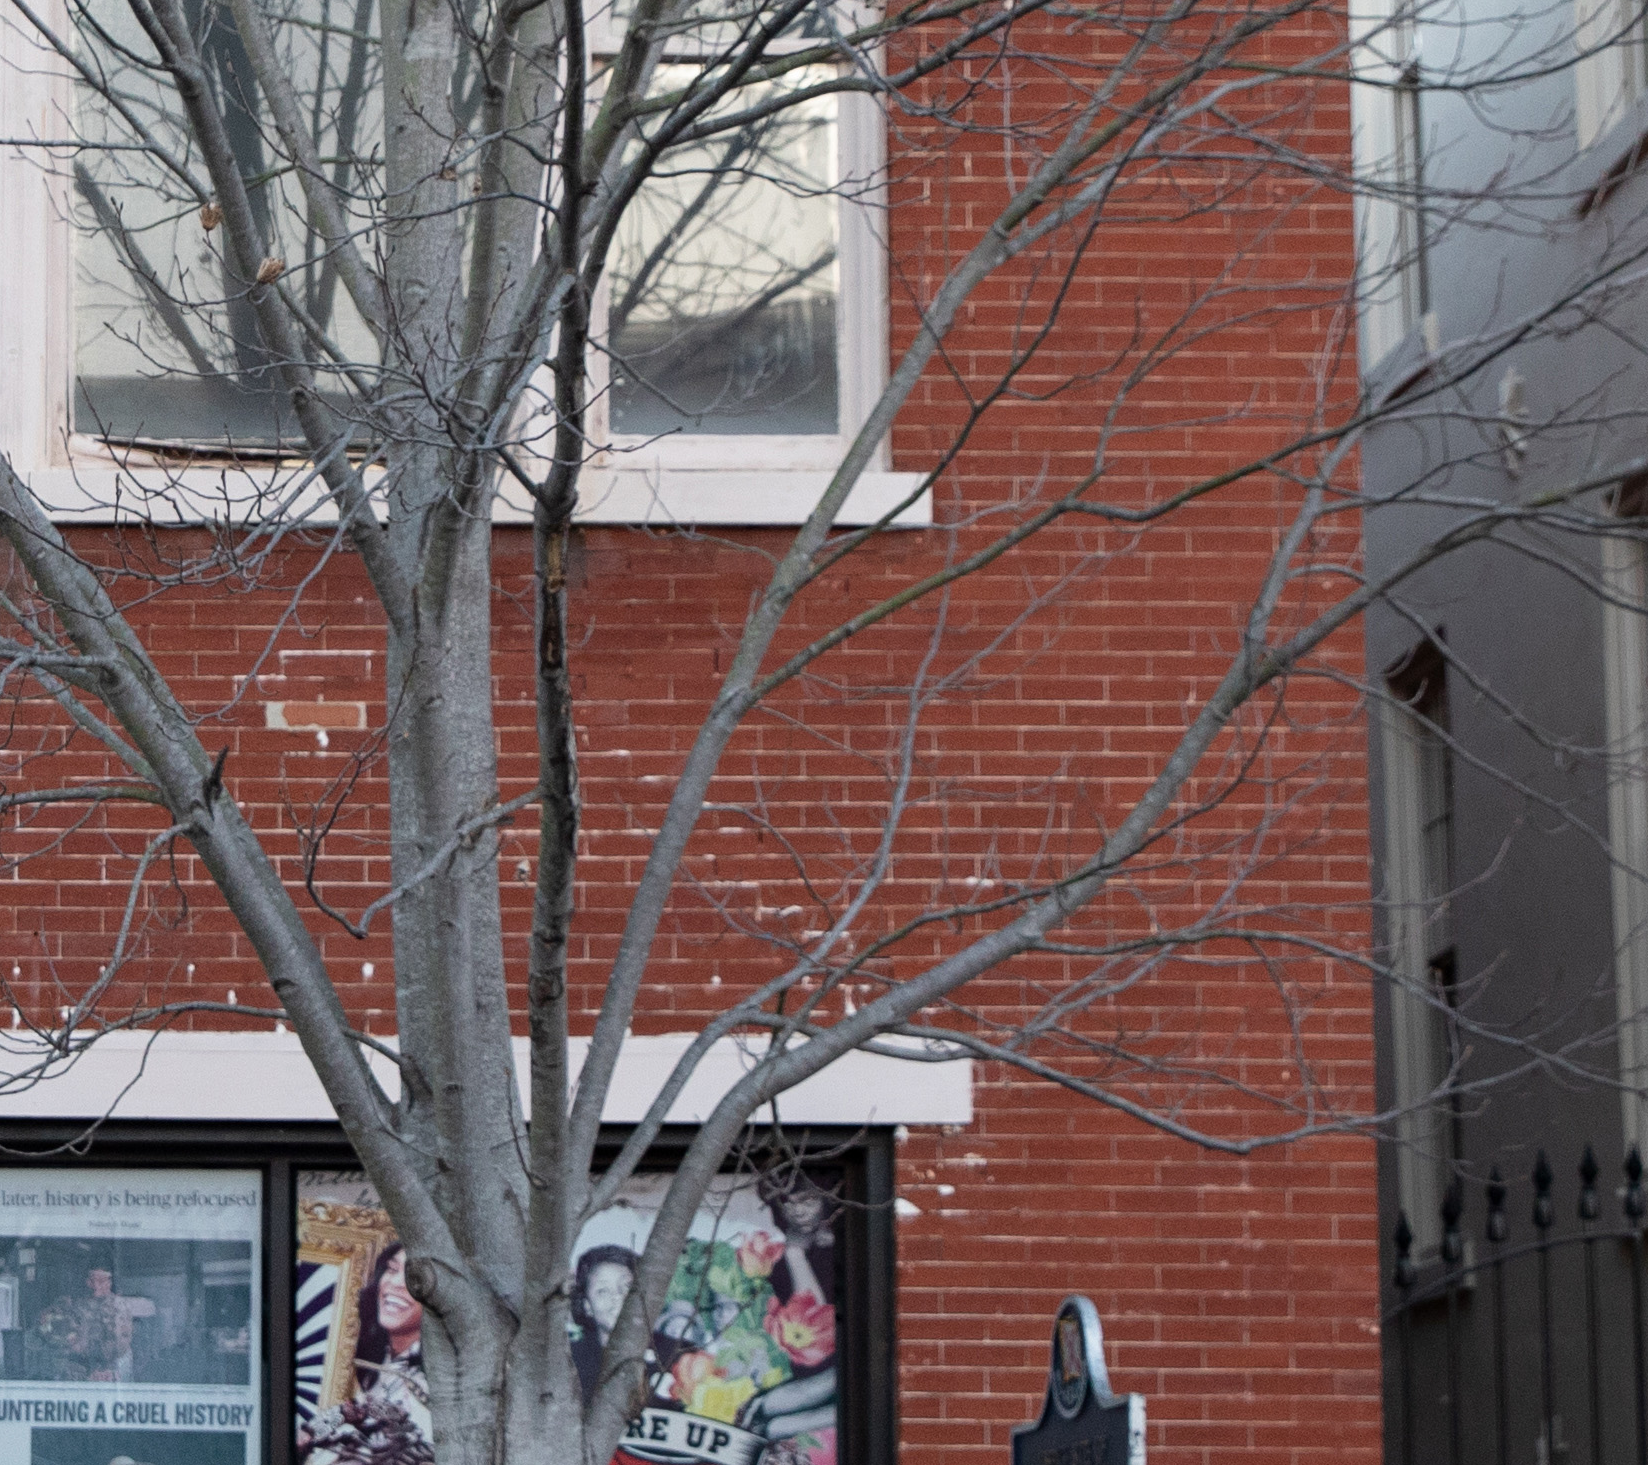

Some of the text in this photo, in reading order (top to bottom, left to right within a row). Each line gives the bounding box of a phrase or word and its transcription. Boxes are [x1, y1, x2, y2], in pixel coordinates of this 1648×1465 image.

[1, 1190, 42, 1208] later,
[45, 1190, 103, 1211] history
[106, 1190, 121, 1207] is
[125, 1190, 172, 1211] being
[174, 1190, 257, 1208] refocused
[94, 1401, 108, 1423] A
[112, 1401, 170, 1425] CRUEL
[174, 1402, 254, 1427] HISTORY
[687, 1423, 731, 1453] UP
